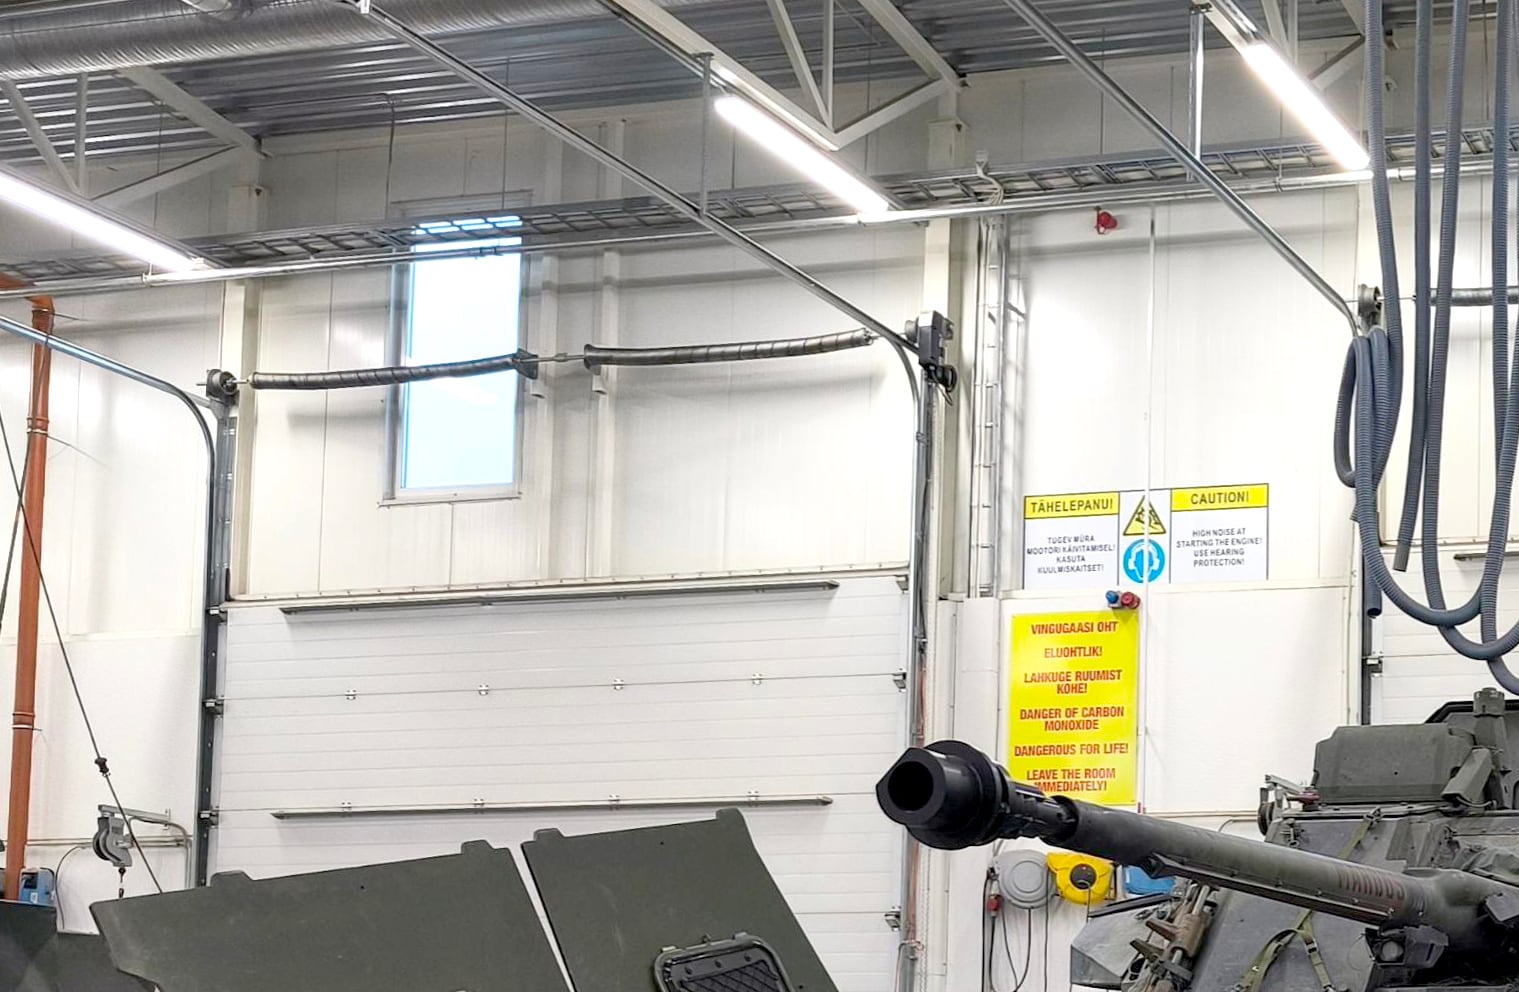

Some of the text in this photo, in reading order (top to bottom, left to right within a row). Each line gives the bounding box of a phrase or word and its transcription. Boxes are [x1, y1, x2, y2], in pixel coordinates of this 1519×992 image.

[1190, 491, 1249, 505] CAUTION!
[1031, 498, 1113, 513] TÄHELEPANU!
[1192, 527, 1246, 537] HIGH NOISE AT
[1048, 536, 1072, 544] TUGEV
[1176, 539, 1214, 548] STARTING
[1215, 538, 1229, 546] THE
[1027, 547, 1061, 555] MOOTORI
[1194, 548, 1245, 557] USE HEARING
[1056, 555, 1086, 563] KASUTA
[1193, 558, 1245, 567] PROTECTION!
[1031, 621, 1118, 634] VINGUGAASI OHT
[1044, 646, 1102, 658] ELUOHTLIK!
[1024, 670, 1123, 683] LAHKUGE RUUMIST
[1057, 683, 1088, 694] KOHE!
[1020, 706, 1125, 720] DANGER OF CARBON
[1044, 720, 1100, 731] MONOXIDE
[1014, 743, 1129, 756] DANGEROUS FOR LIFE!
[1027, 768, 1116, 781] LEAVE THE ROOM
[1034, 781, 1107, 792] MMEDIATELY!
